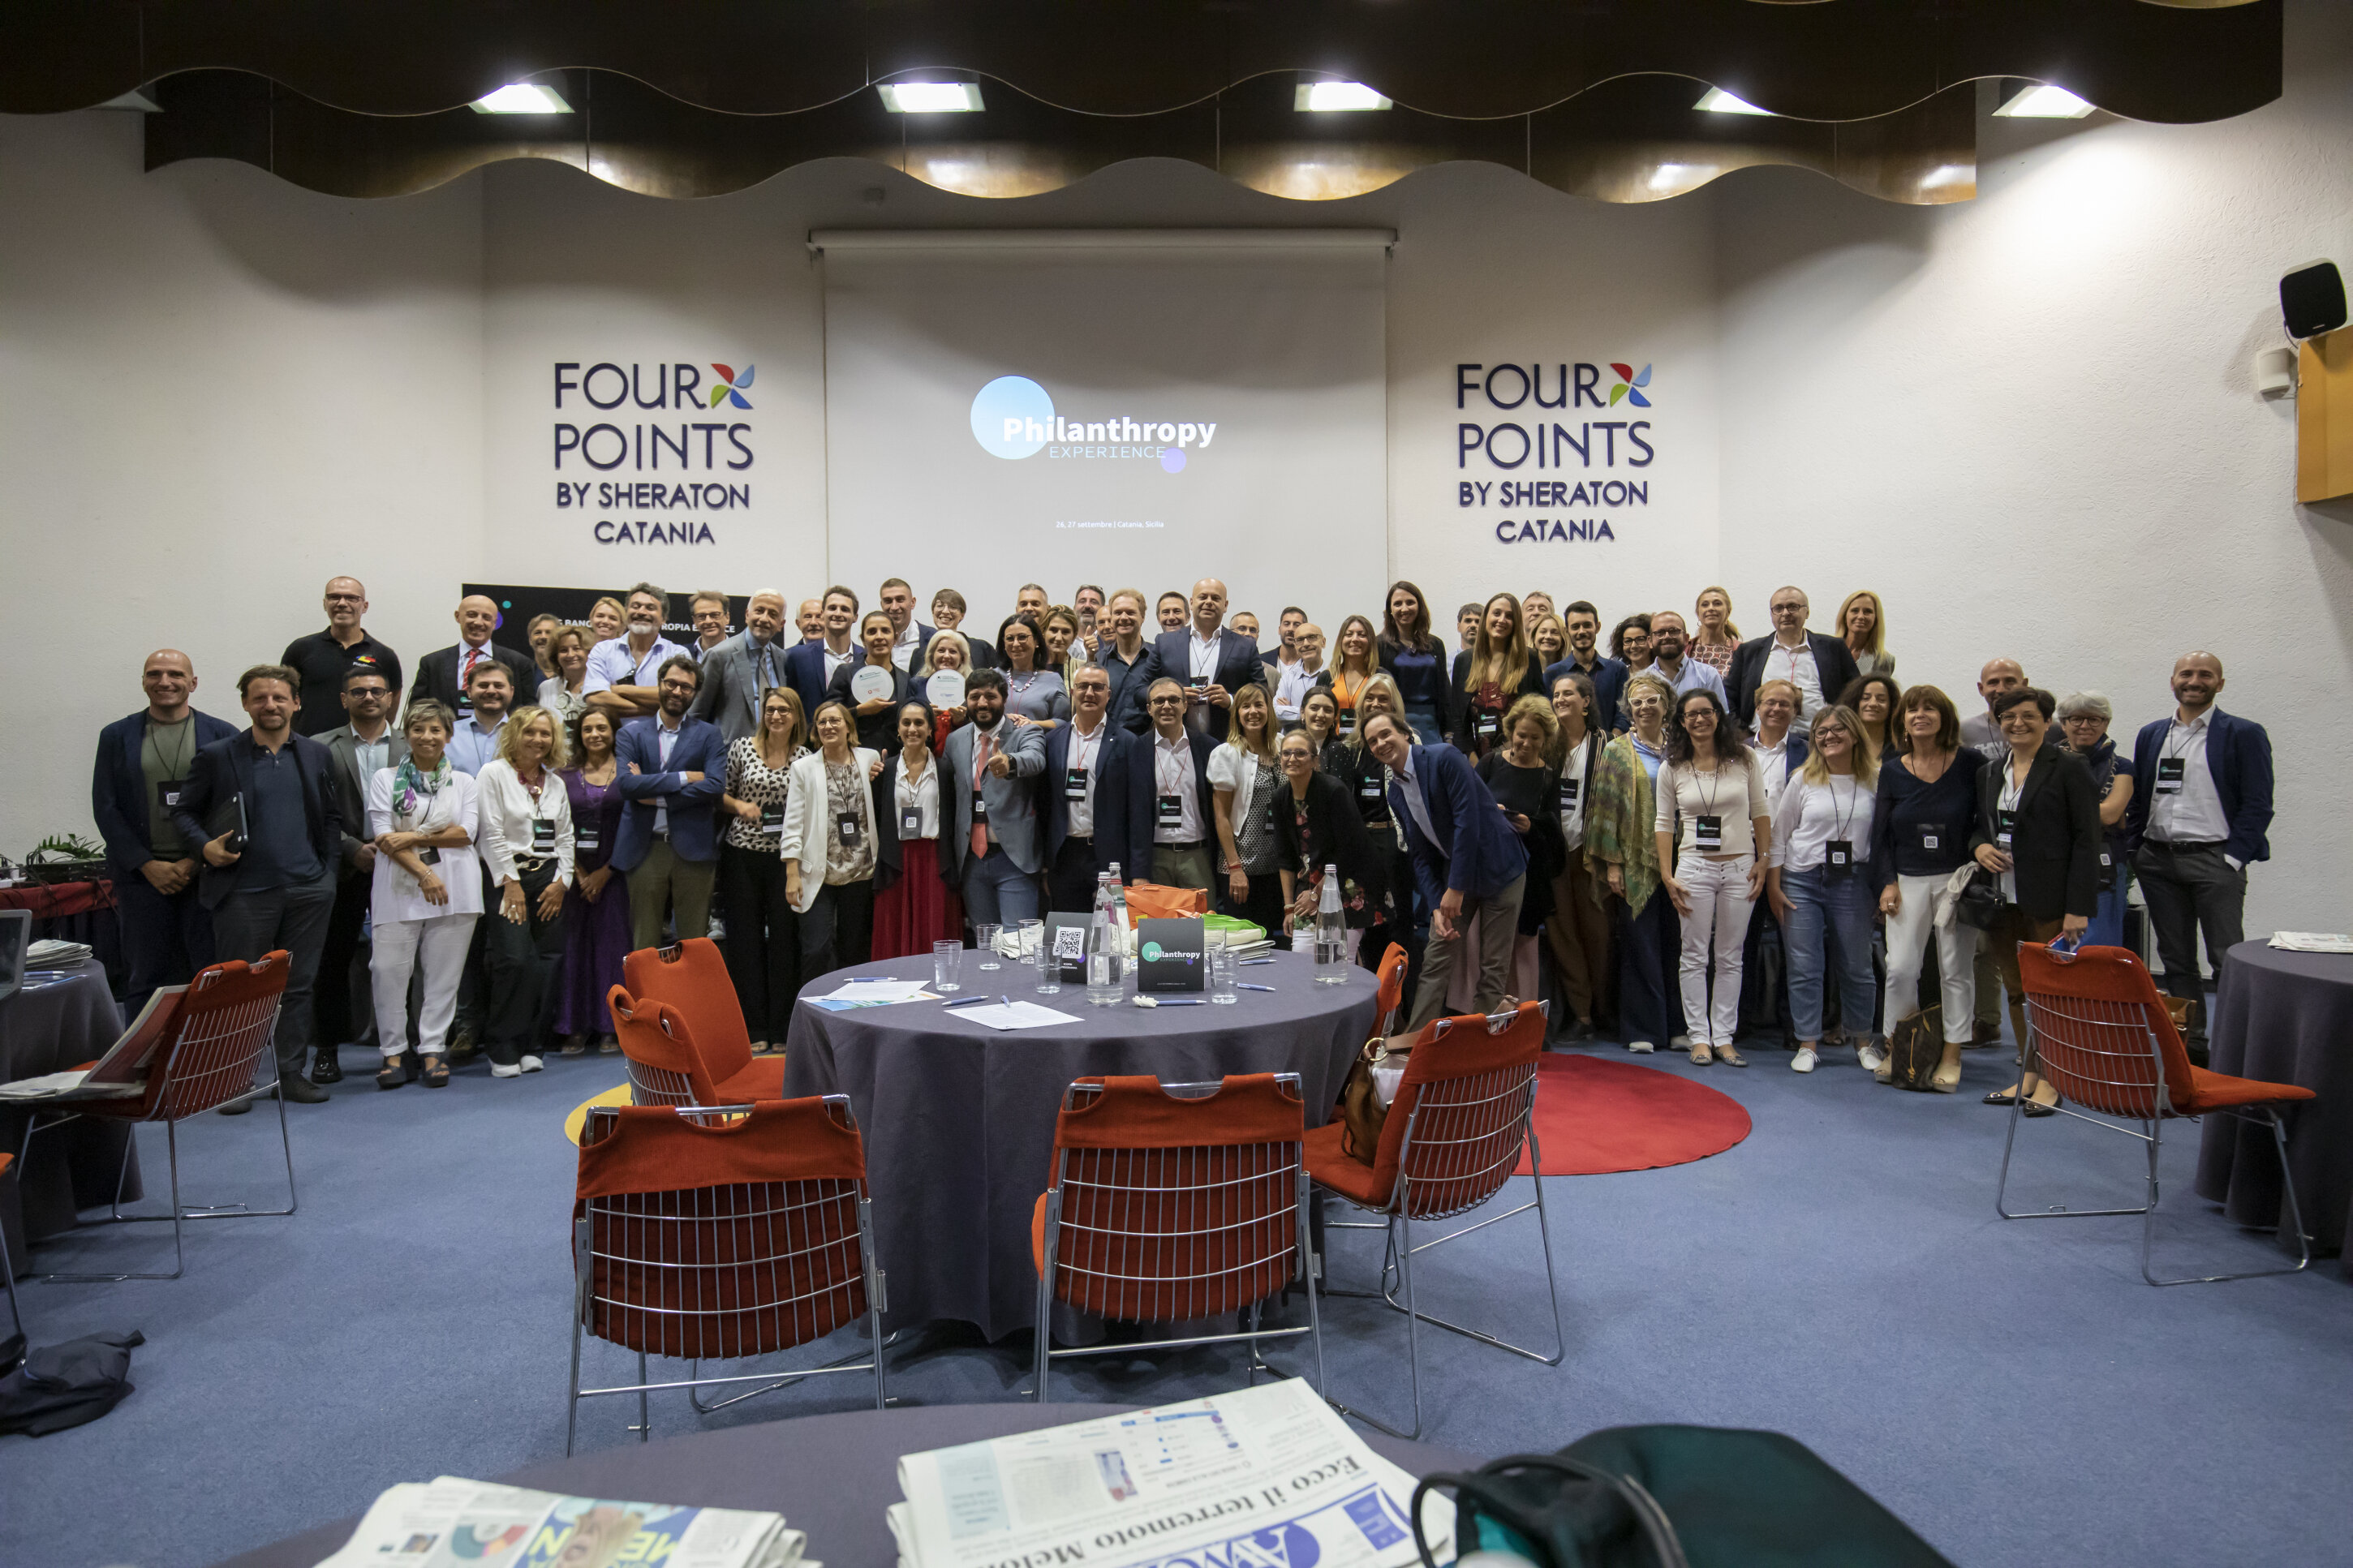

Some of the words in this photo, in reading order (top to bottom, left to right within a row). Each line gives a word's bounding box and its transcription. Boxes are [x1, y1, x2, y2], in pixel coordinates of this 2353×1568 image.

[555, 363, 707, 410] FOUR
[1456, 363, 1607, 410] FOUR
[1003, 416, 1216, 448] Philanthropy
[1458, 421, 1654, 470] POINTS
[555, 423, 754, 470] POINTS
[1049, 446, 1167, 458] EXPERIENCE
[557, 482, 591, 509] BY
[598, 482, 750, 510] SHERATON
[1458, 481, 1493, 507] BY
[1499, 480, 1648, 508] SHERATON
[594, 521, 715, 545] CATANIA
[1056, 521, 1066, 529] 26,
[1117, 521, 1144, 529] Catania,
[1495, 518, 1615, 543] CATANIA
[1149, 951, 1201, 959] Philanthropy
[1292, 1455, 1361, 1491] Ecco
[1261, 1486, 1288, 1507] il
[1095, 1496, 1255, 1549] terremoto
